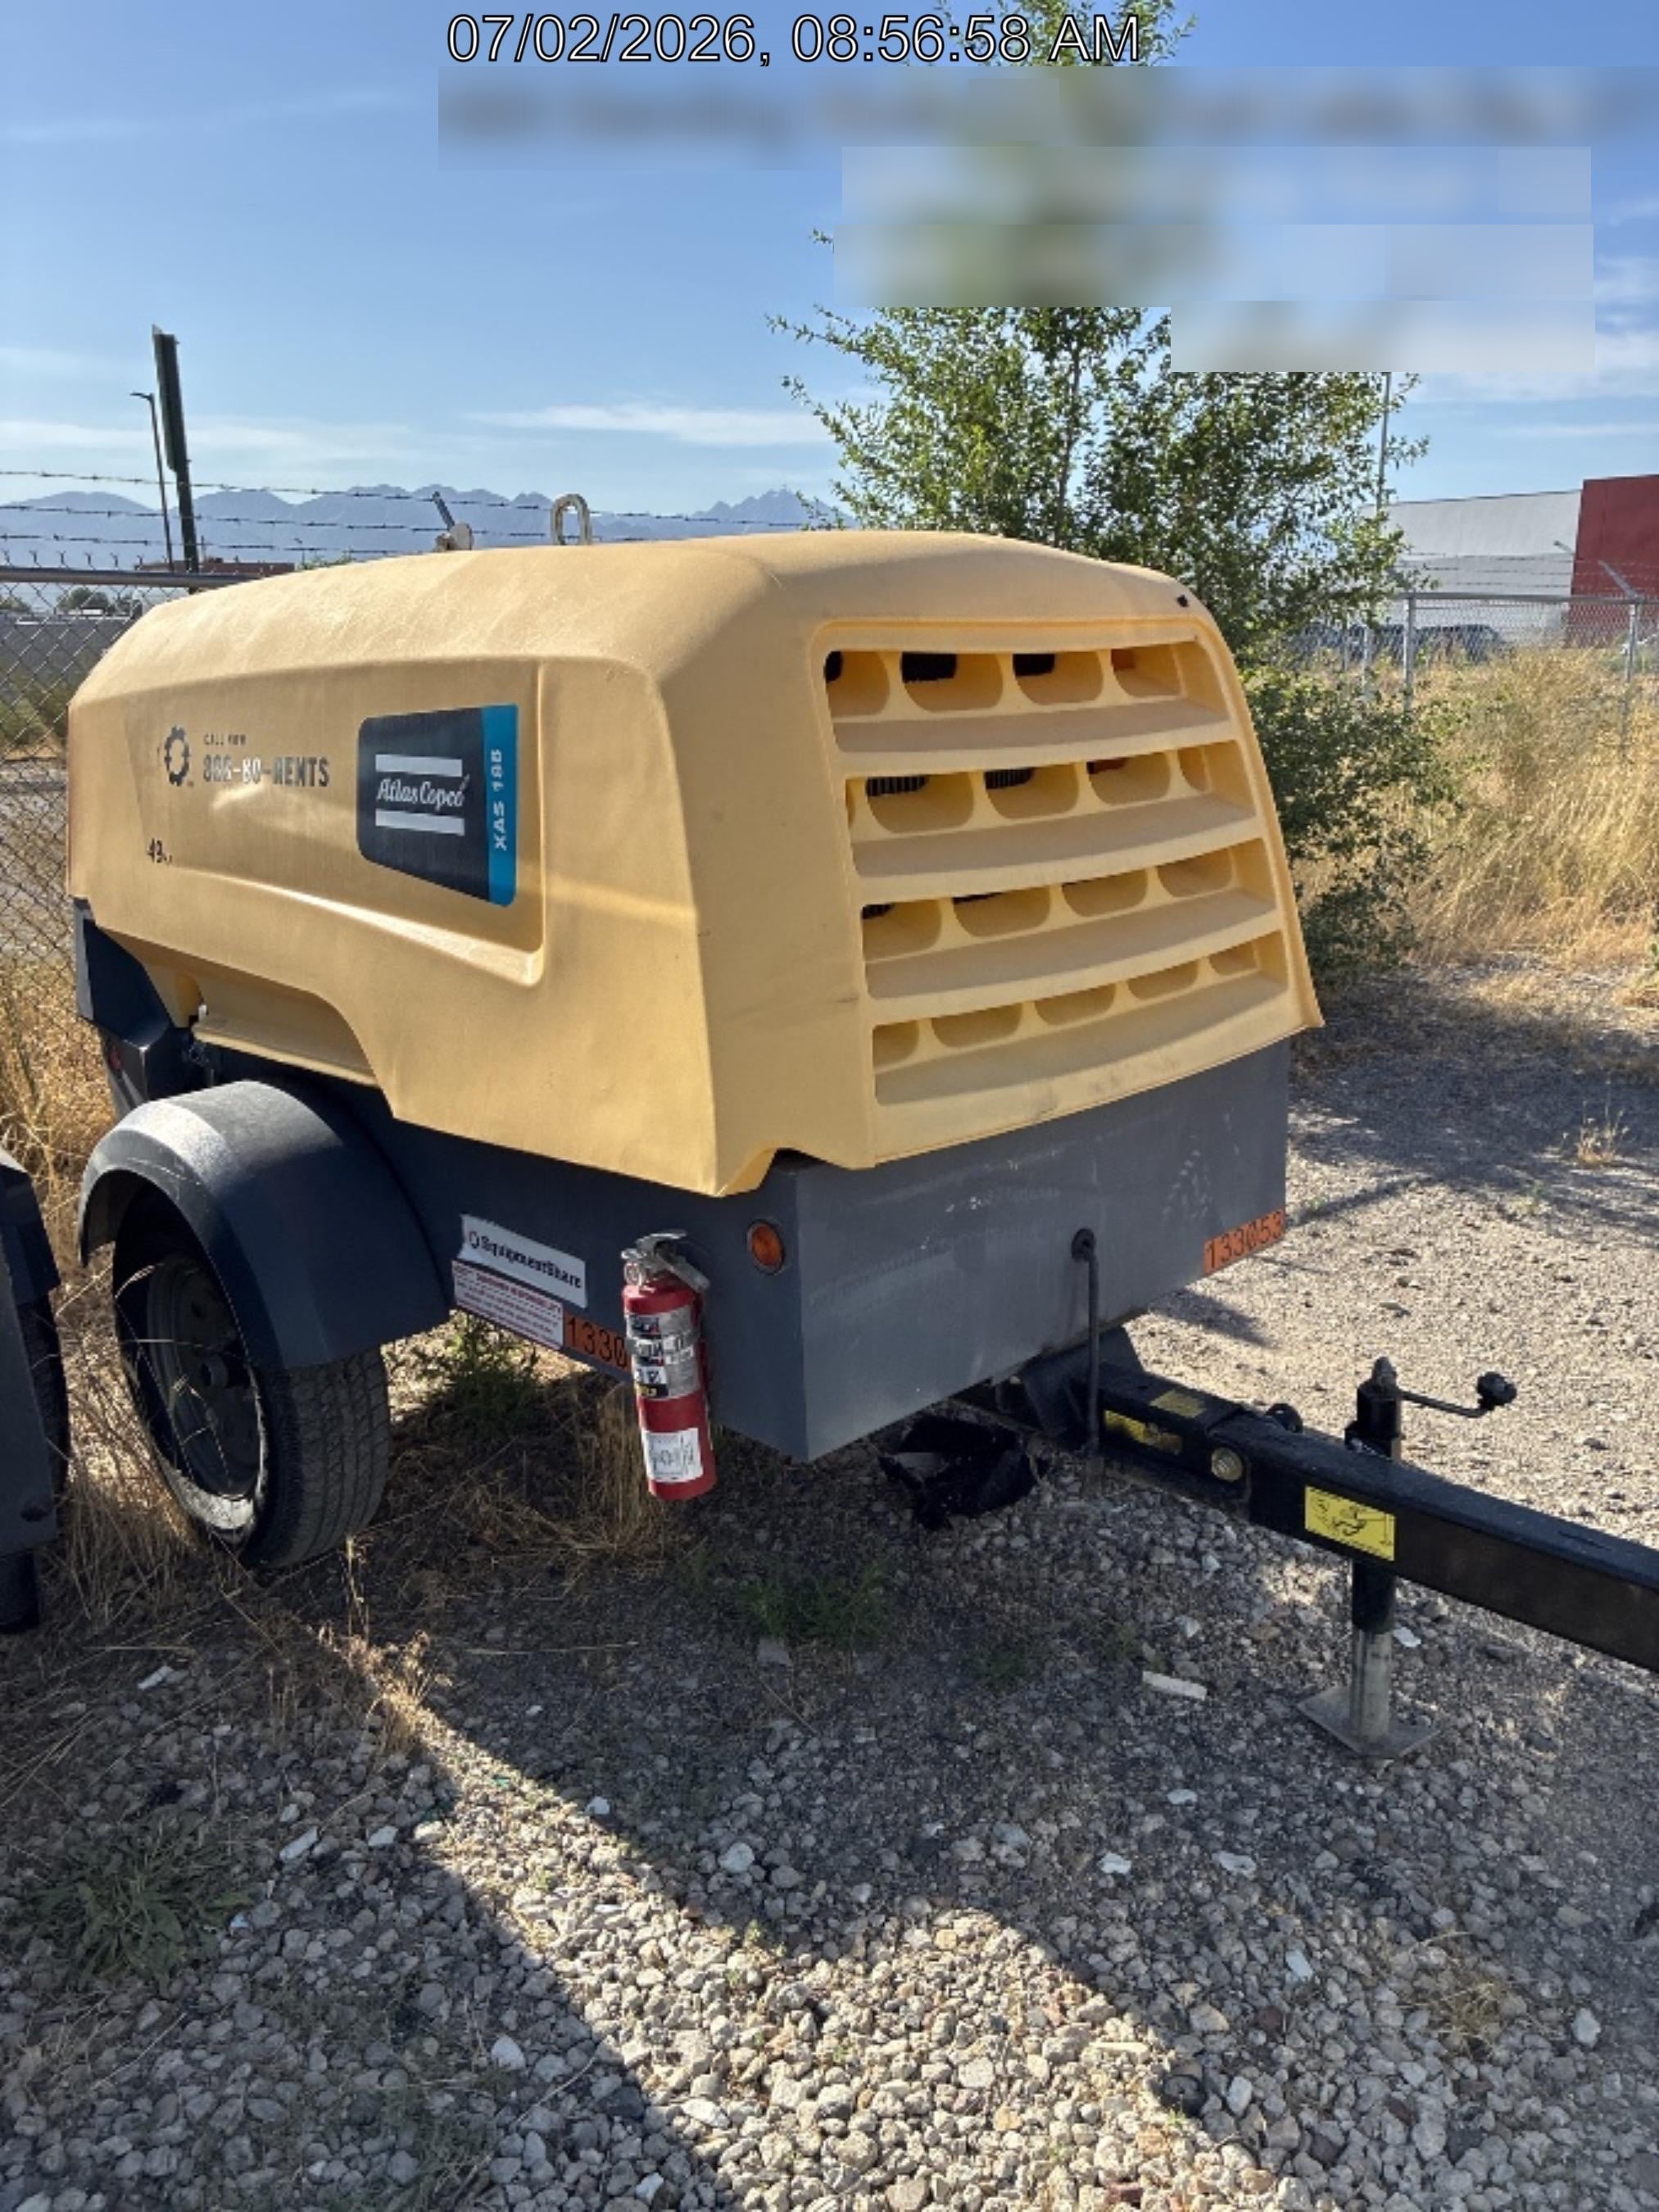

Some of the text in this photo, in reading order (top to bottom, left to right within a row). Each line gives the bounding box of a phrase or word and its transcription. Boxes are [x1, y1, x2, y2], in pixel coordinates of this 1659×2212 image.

[376, 773, 469, 812] Atlas Copco
[493, 801, 507, 851] XAS
[480, 1235, 582, 1290] EquipmentShare
[567, 1317, 628, 1368] 1330
